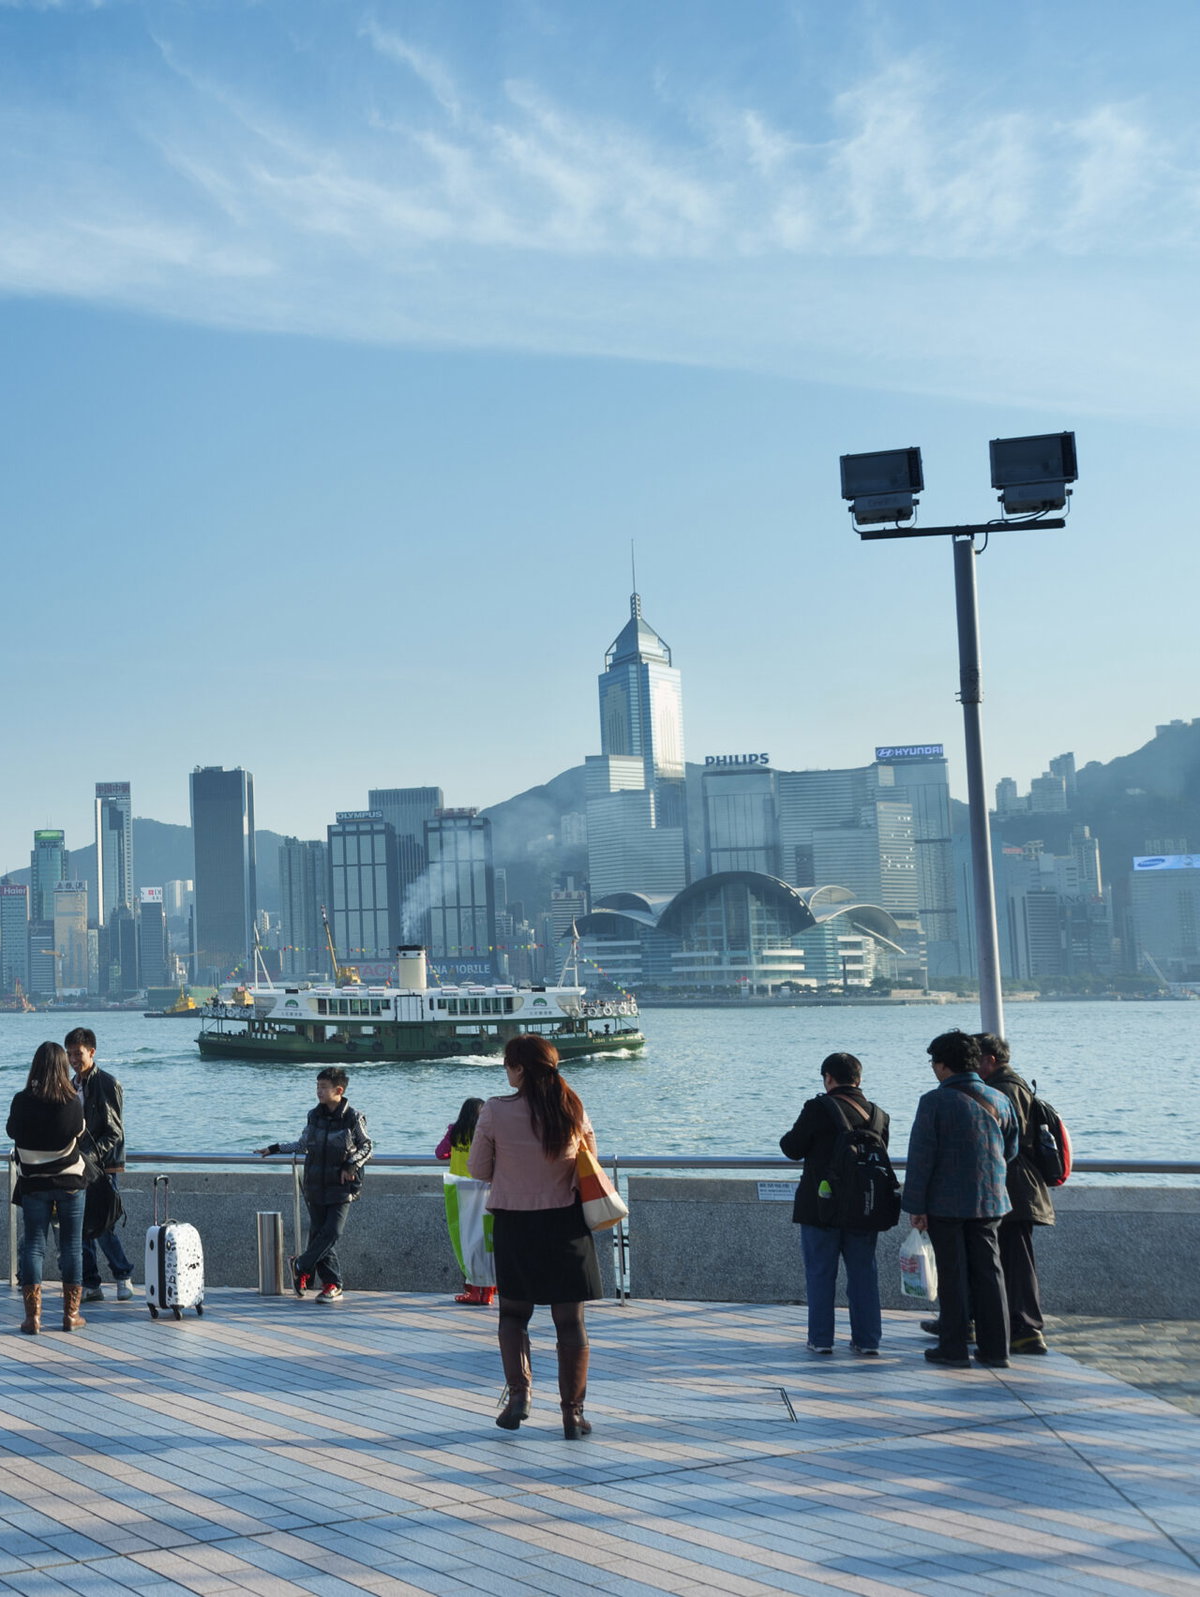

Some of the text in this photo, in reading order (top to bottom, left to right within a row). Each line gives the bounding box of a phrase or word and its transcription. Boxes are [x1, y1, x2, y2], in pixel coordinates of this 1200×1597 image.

[895, 746, 943, 756] HYUNDAI
[705, 753, 769, 767] PHILIPS
[337, 811, 383, 819] OLYMPUS
[4, 887, 26, 895] Haier
[1059, 895, 1086, 904] ING
